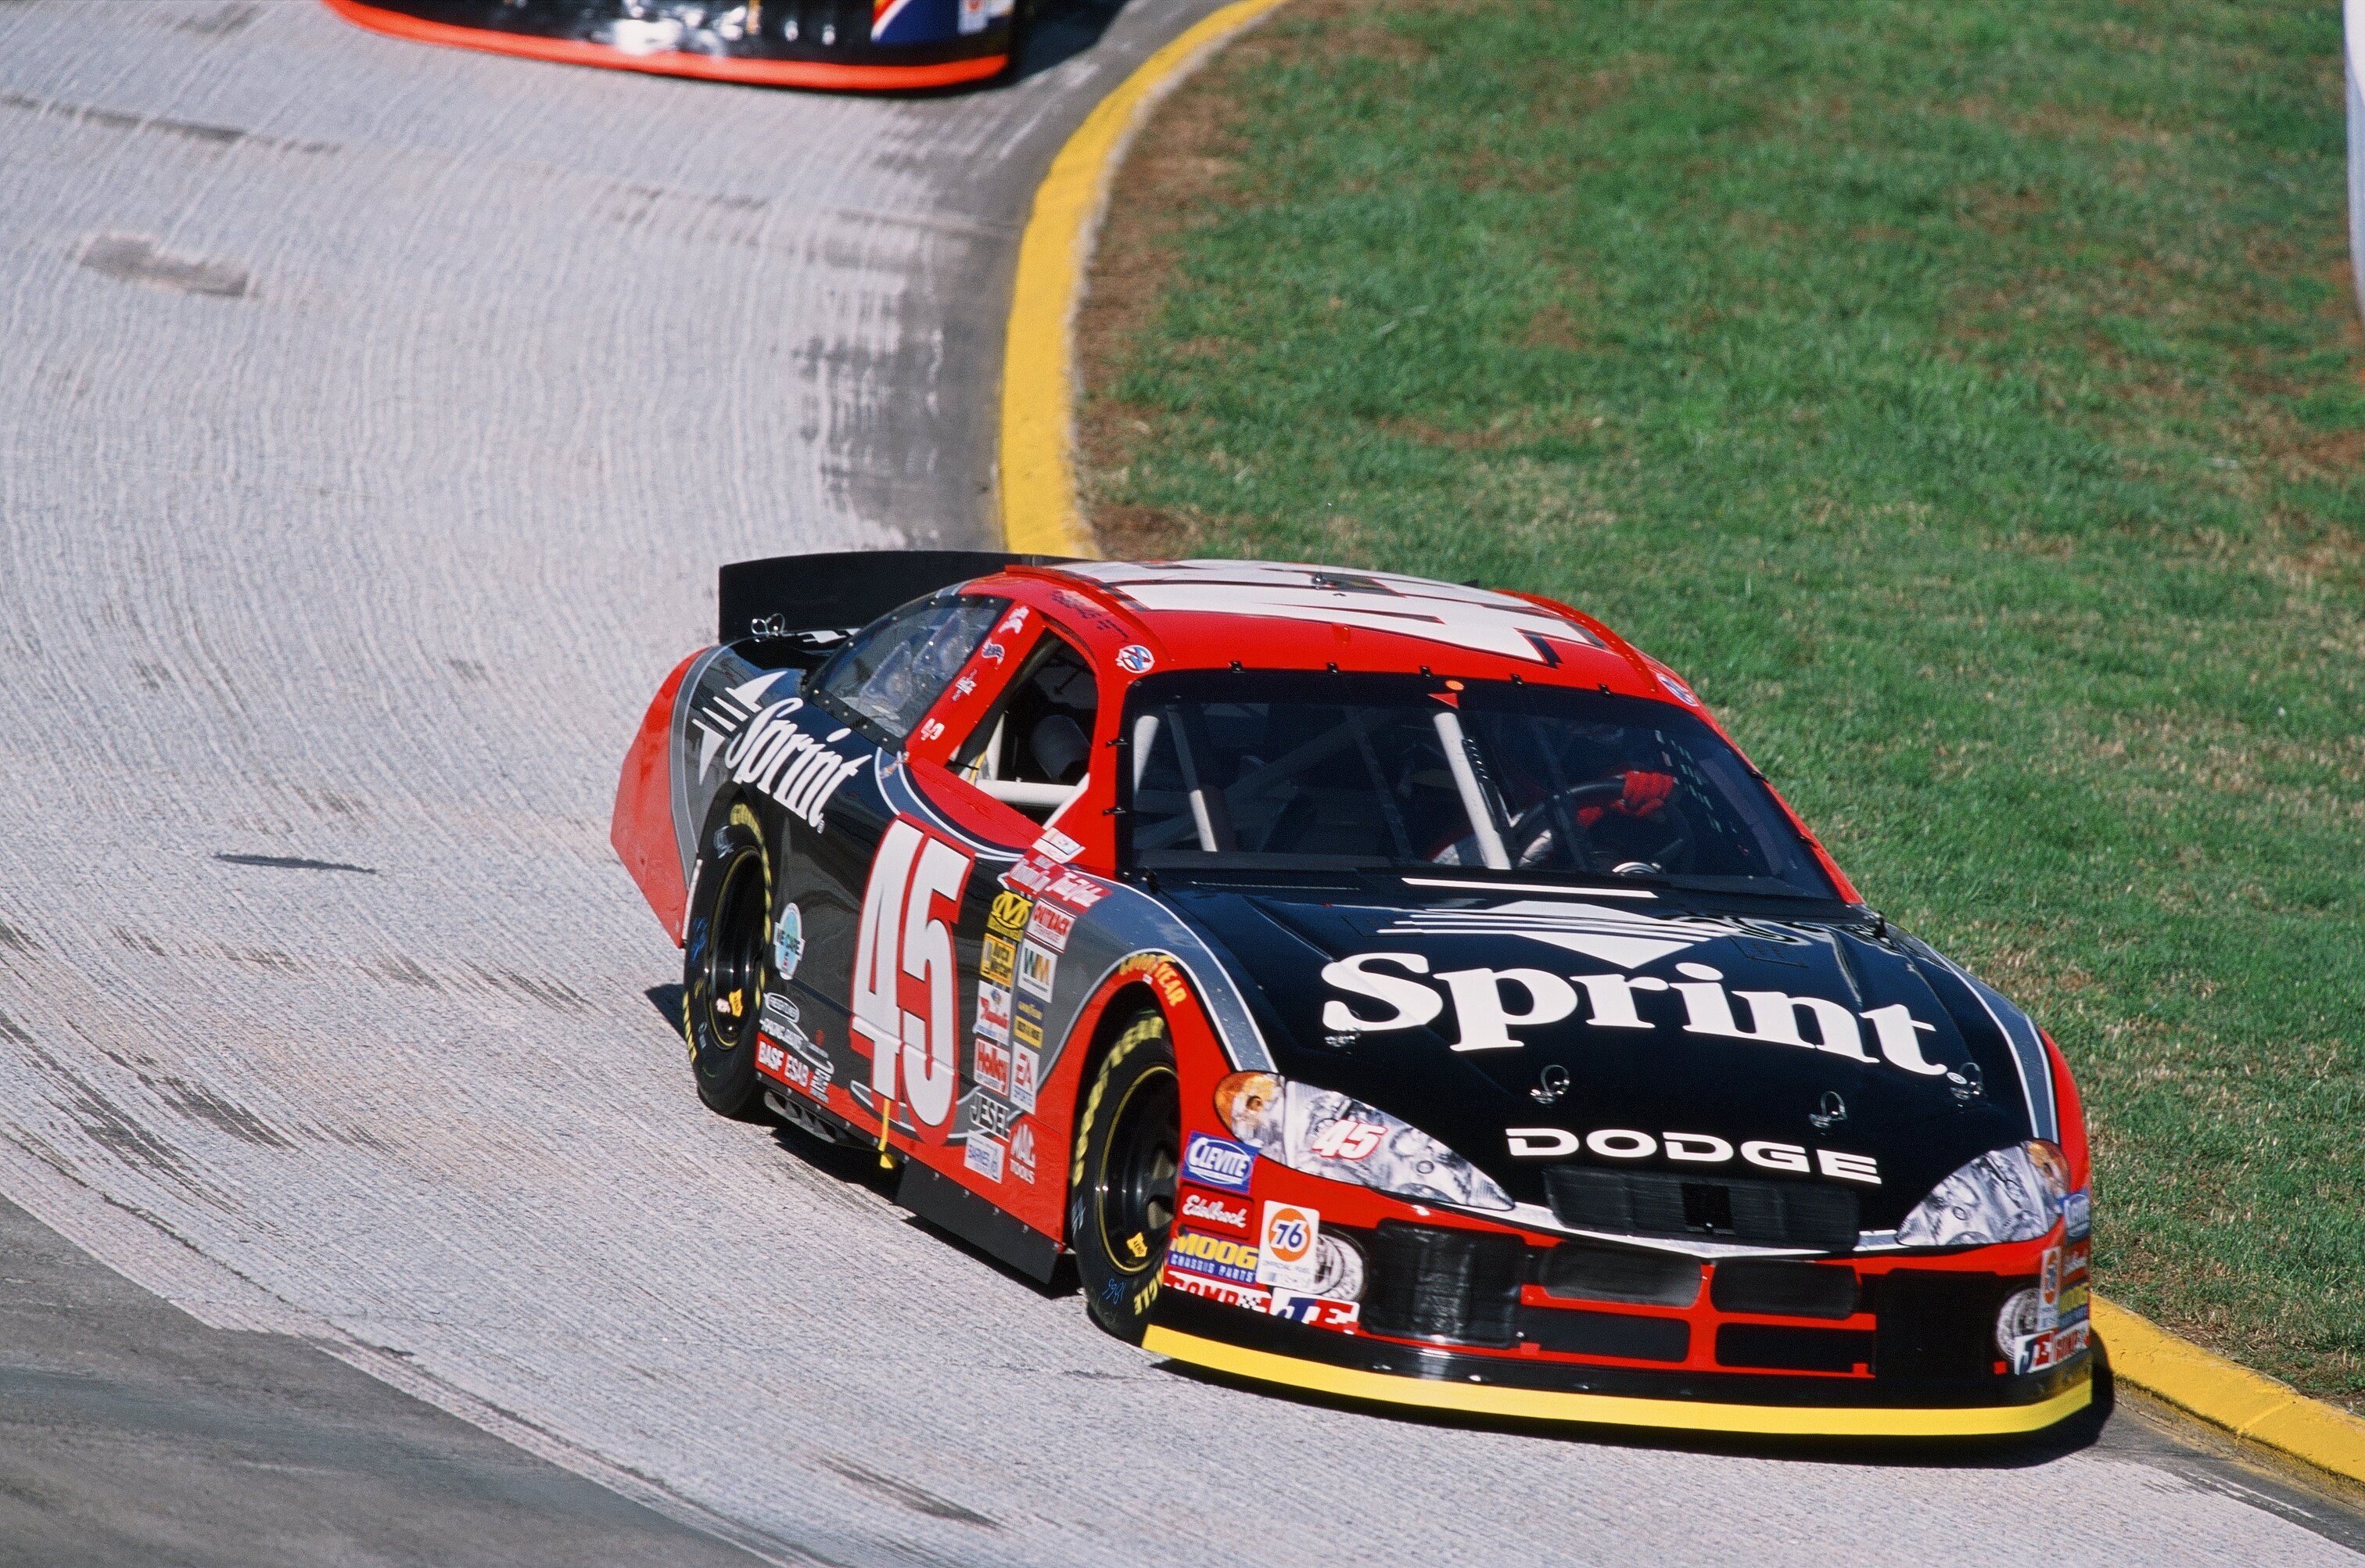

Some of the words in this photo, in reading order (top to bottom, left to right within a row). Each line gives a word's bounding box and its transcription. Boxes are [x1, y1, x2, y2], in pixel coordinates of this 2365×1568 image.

[725, 698, 873, 827] Sprint
[851, 819, 971, 1126] 45
[1322, 953, 1947, 1076] Sprint
[758, 1041, 784, 1072] BASF
[784, 1054, 809, 1088] ESAB
[977, 1041, 1010, 1093] Holley
[1015, 1053, 1032, 1093] EA
[970, 1092, 1010, 1143] JESEL
[1010, 1123, 1036, 1168] MAC
[1188, 1136, 1251, 1179] CLEVITE
[1312, 1119, 1387, 1162] 45
[1506, 1127, 1882, 1186] DODGE
[1010, 1158, 1035, 1185] TOOLS
[1182, 1194, 1248, 1228] Edelbrock
[1171, 1232, 1259, 1270] MOOG
[1270, 1219, 1307, 1256] 76
[1171, 1254, 1215, 1275] CHASSIS
[1218, 1263, 1255, 1284] PARTS
